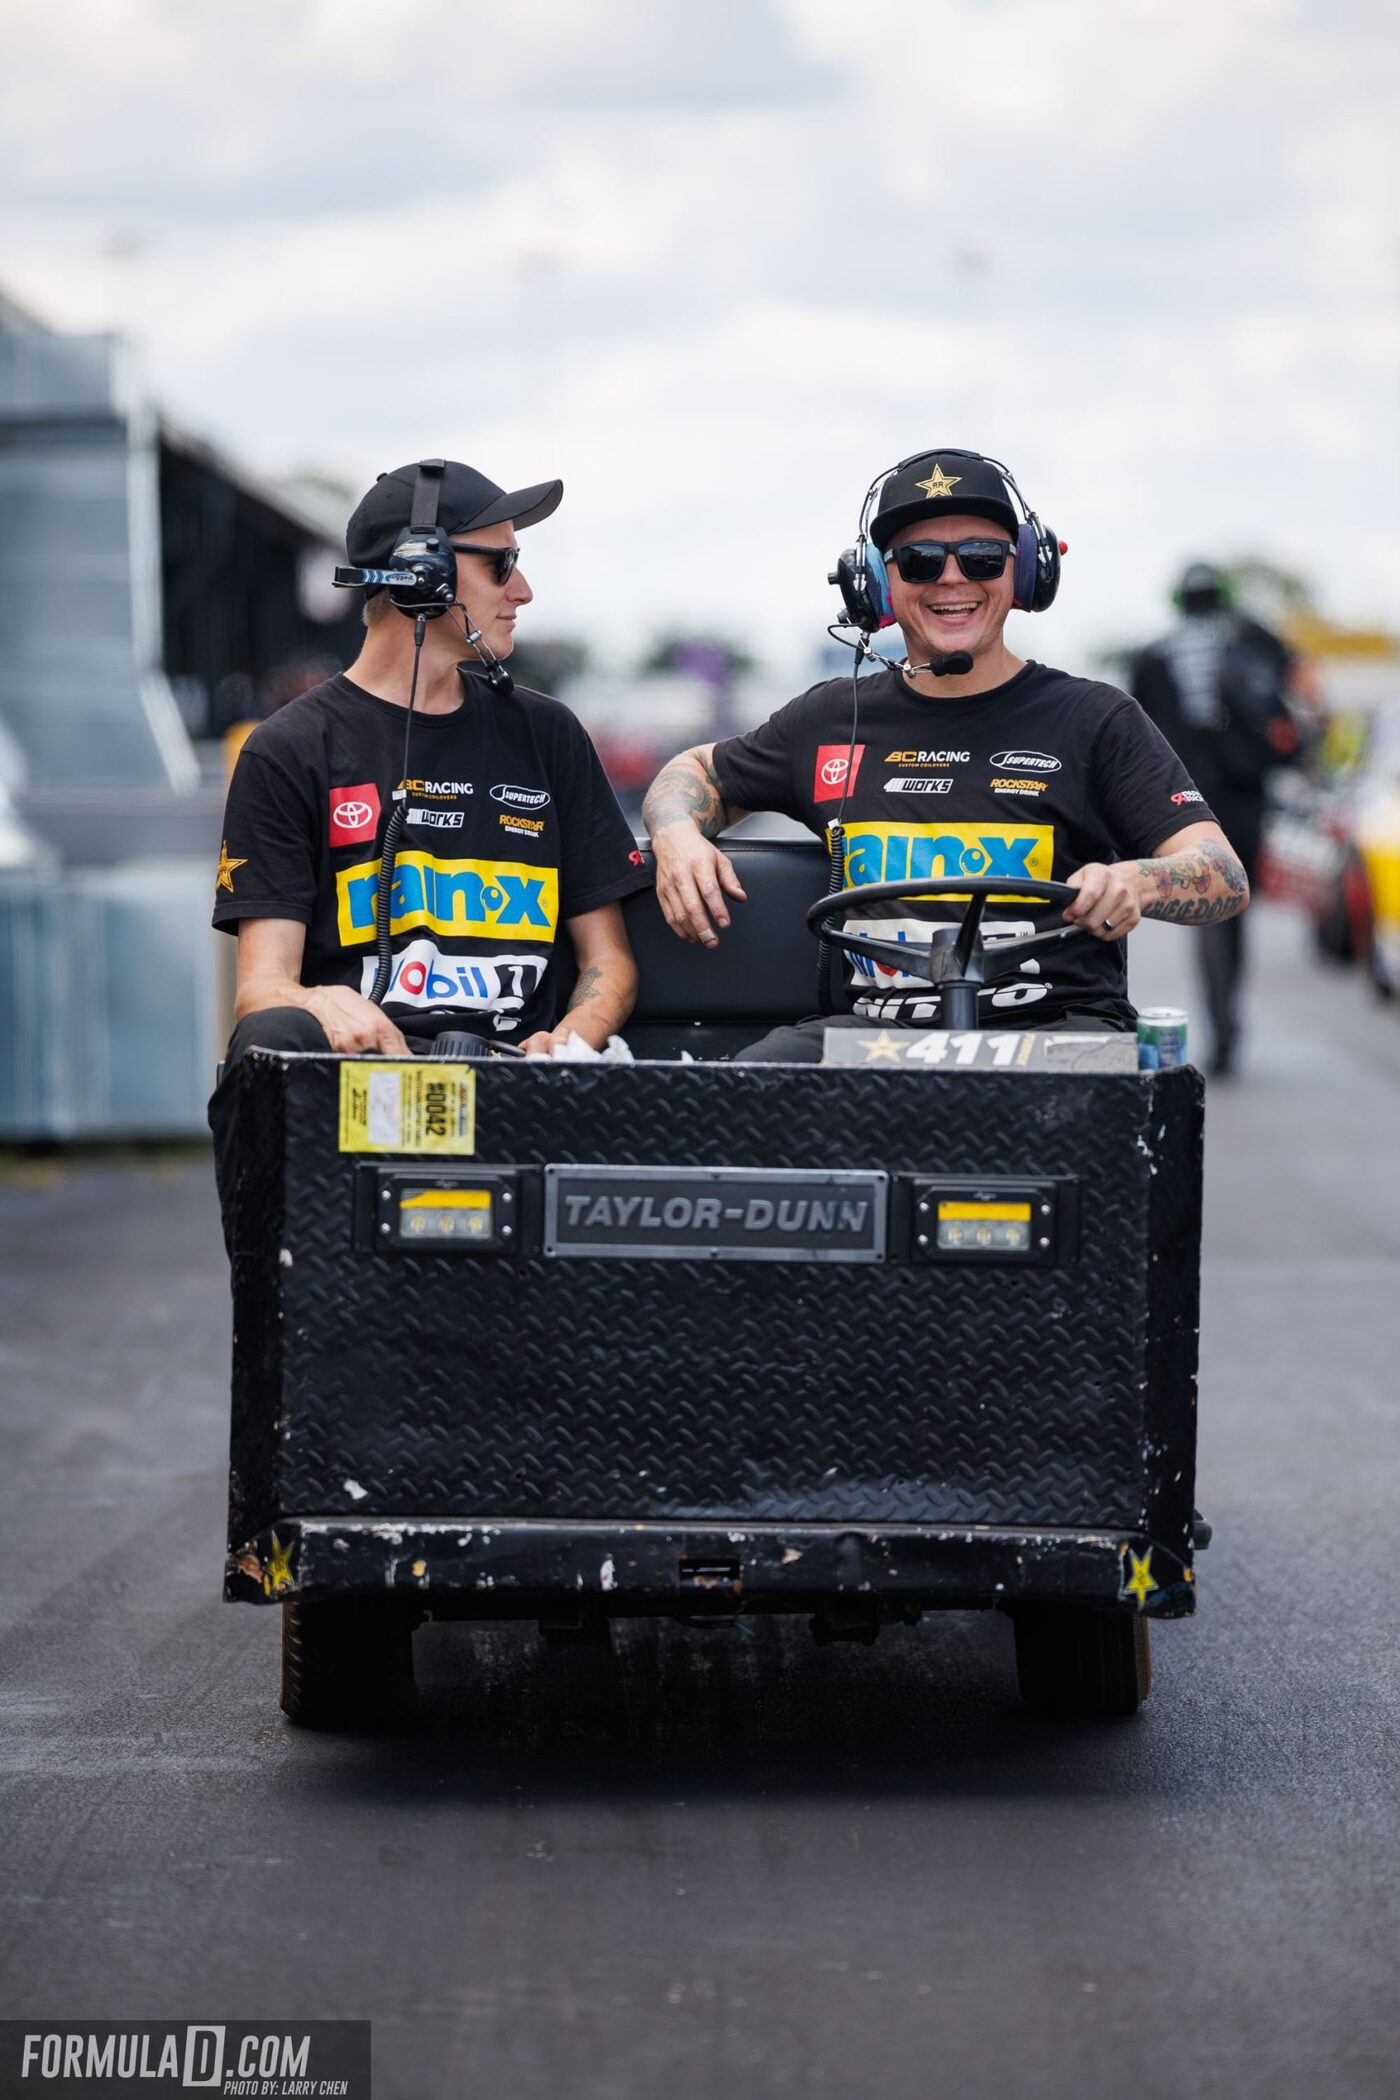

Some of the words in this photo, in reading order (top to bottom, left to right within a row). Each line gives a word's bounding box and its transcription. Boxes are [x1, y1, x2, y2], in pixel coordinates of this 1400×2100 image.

[990, 778, 1048, 792] ROCKSTAR
[499, 814, 545, 832] ROCKSTAR
[507, 965, 523, 998] 1
[905, 1033, 1020, 1066] 411
[564, 1195, 870, 1233] TAYLOR-DUNN
